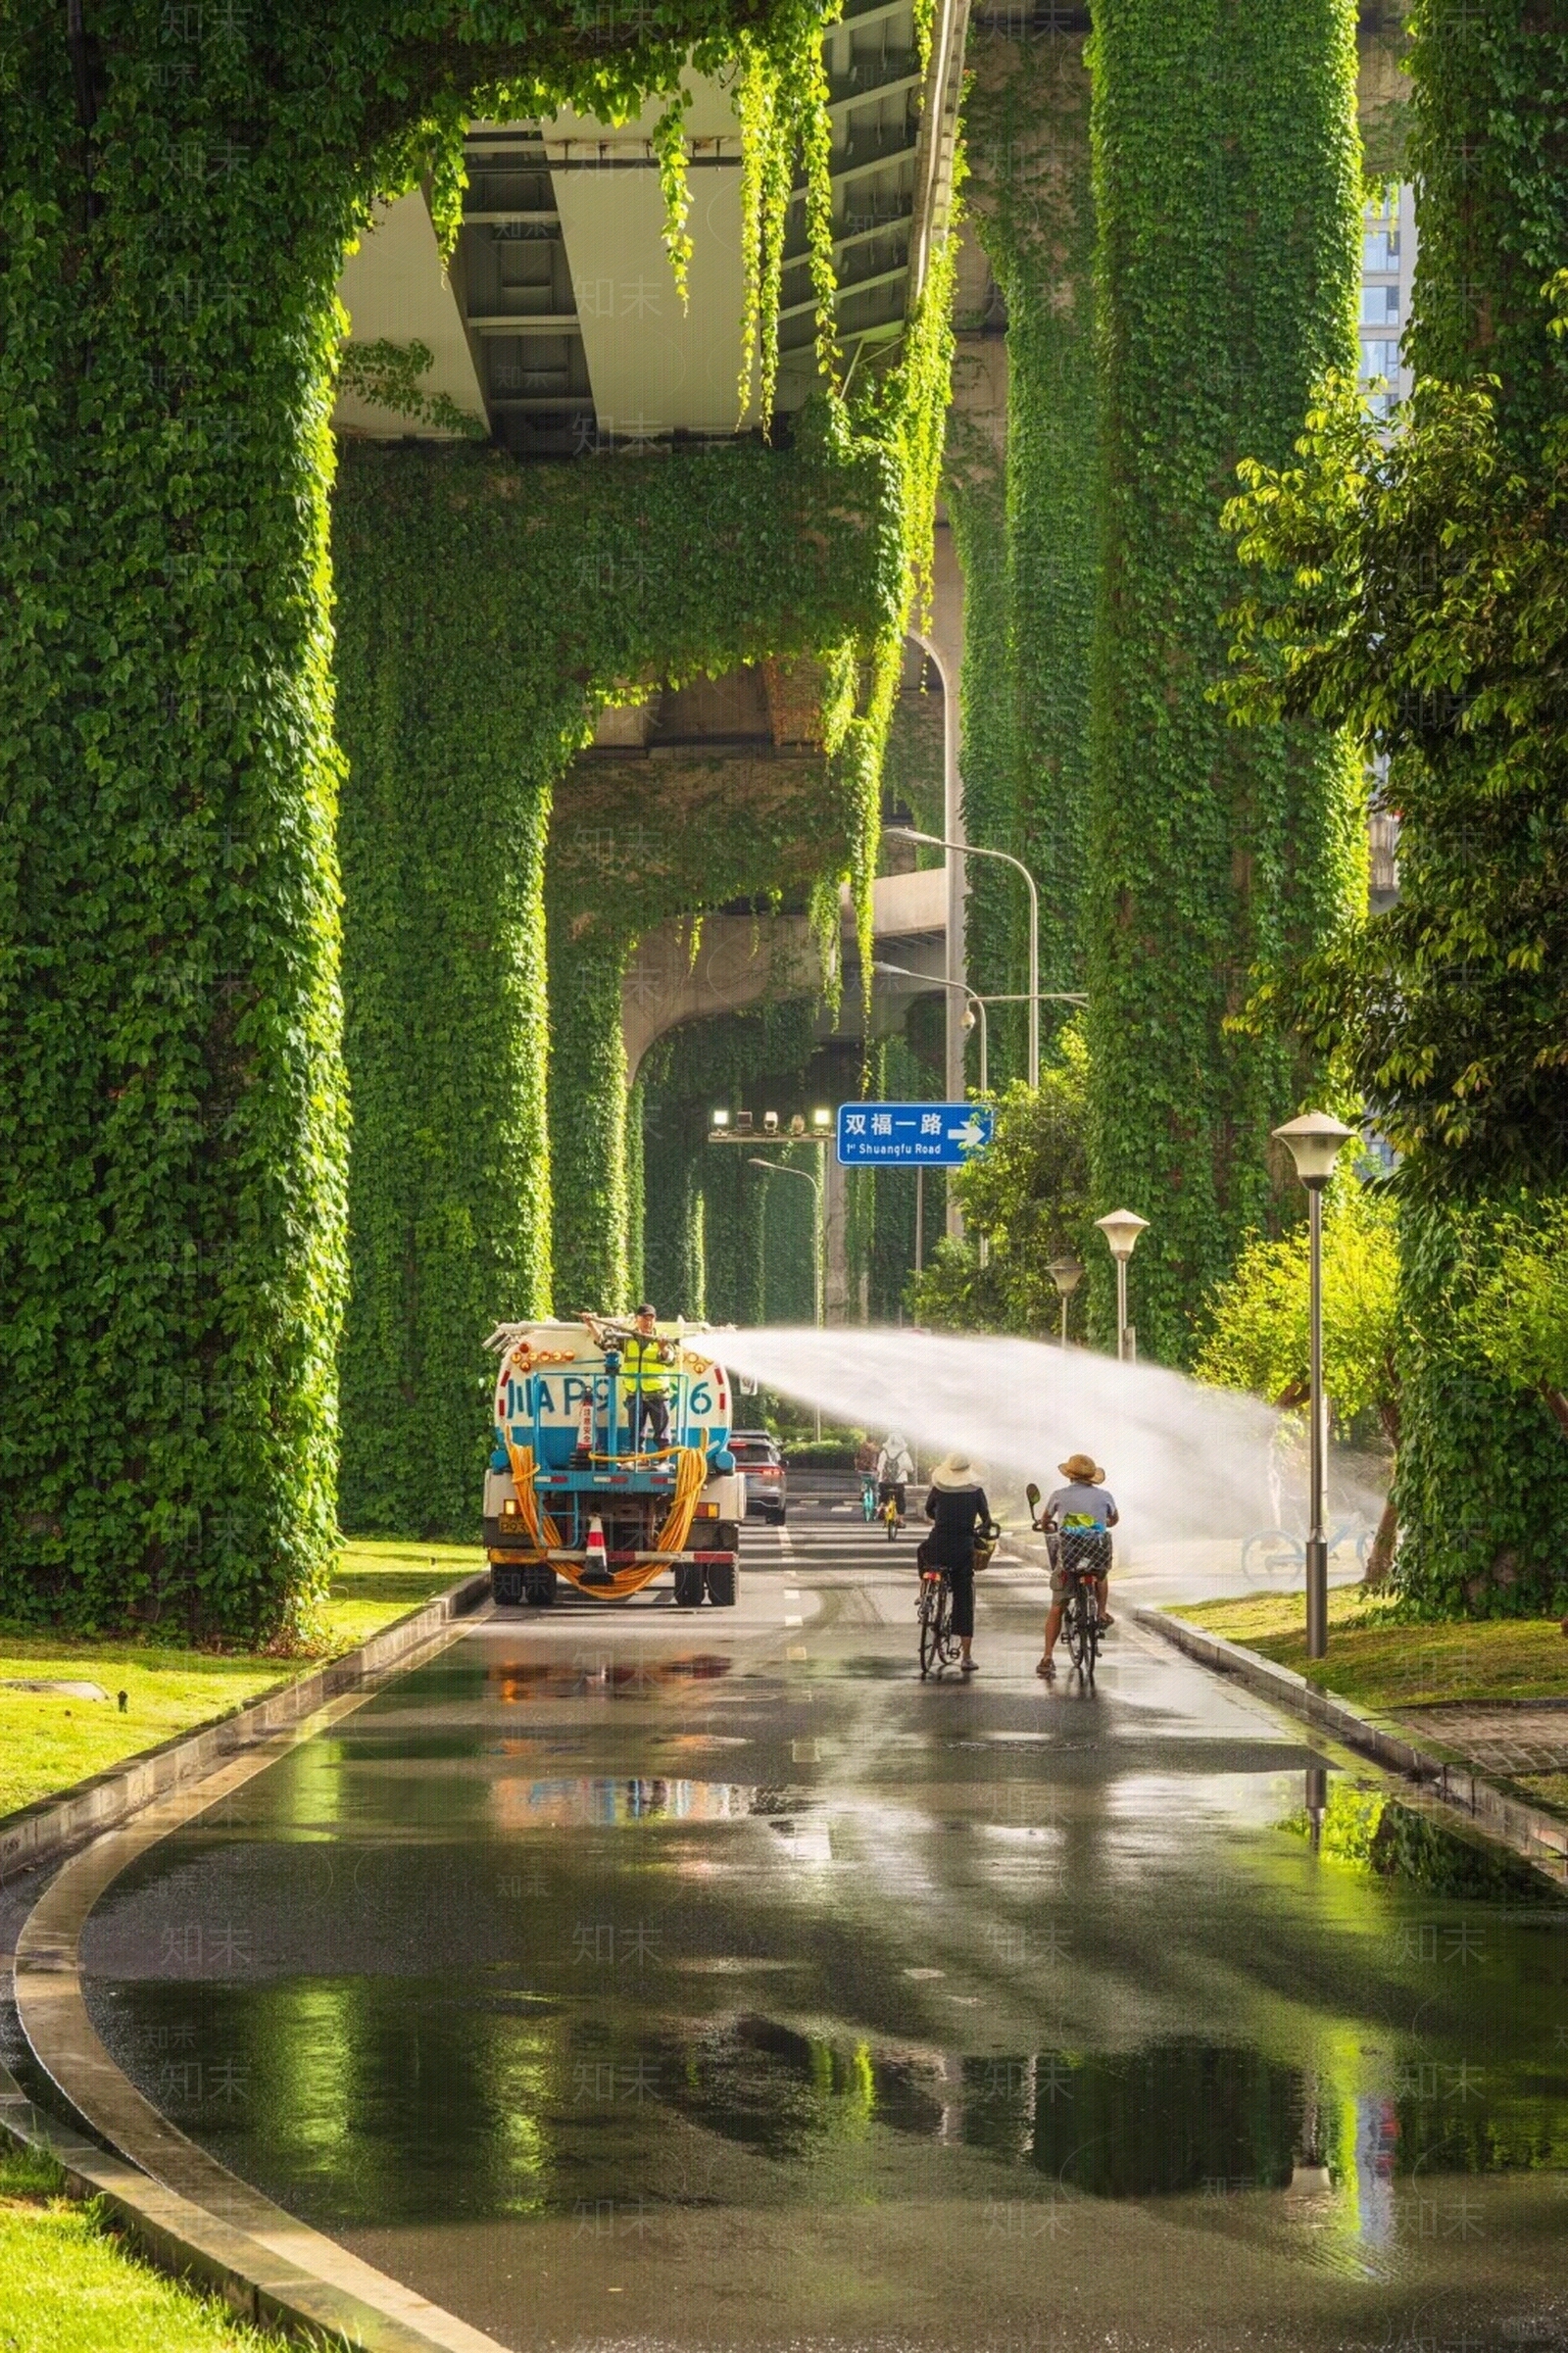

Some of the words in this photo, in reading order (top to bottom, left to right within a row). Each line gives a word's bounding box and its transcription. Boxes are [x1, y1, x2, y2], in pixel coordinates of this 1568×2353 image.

[846, 1114, 942, 1135] 双福一路
[858, 1143, 911, 1157] Shuangfu
[915, 1143, 941, 1154] Road
